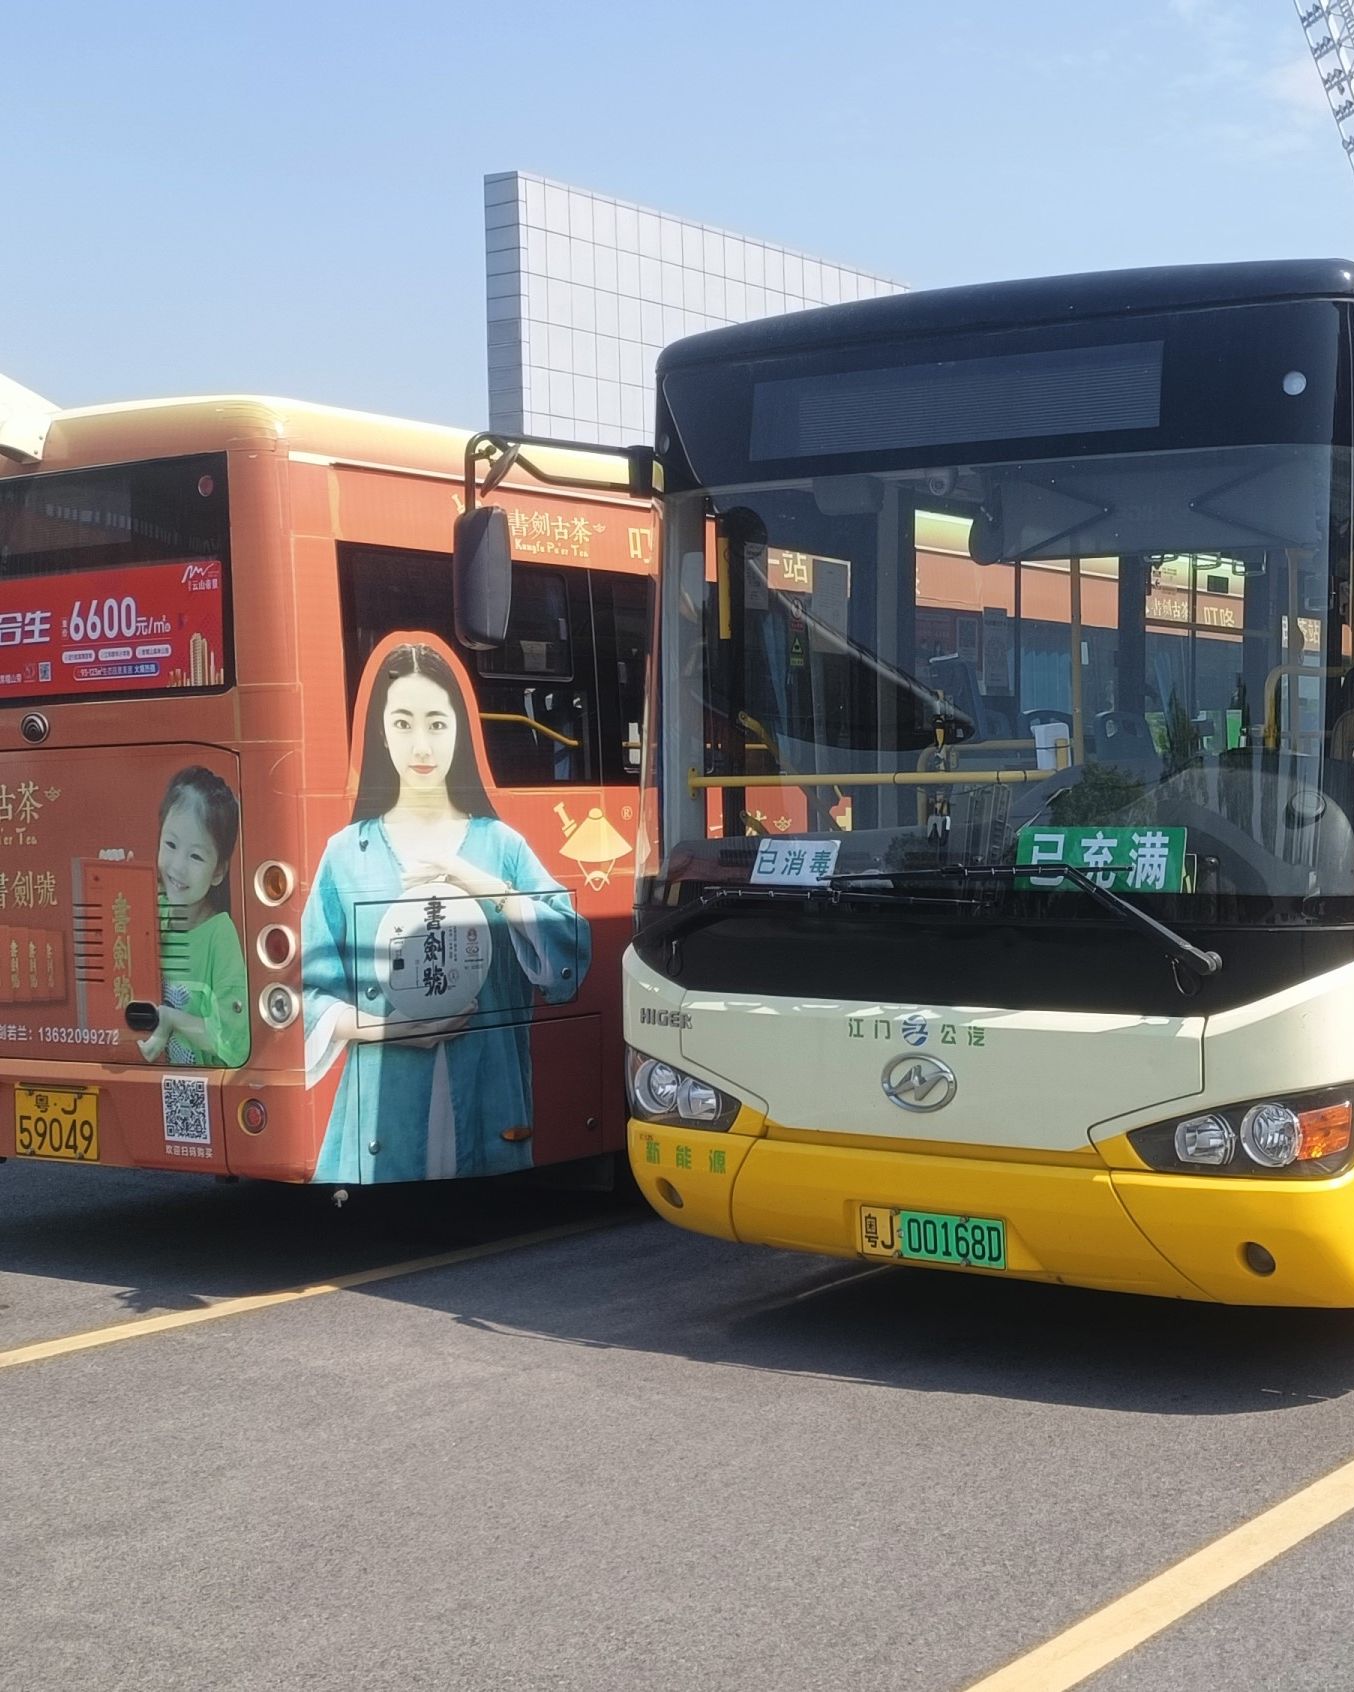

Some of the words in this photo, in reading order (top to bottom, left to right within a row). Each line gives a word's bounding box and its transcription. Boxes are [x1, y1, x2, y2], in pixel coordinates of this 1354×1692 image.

[508, 508, 592, 544] 書劍古茶
[15, 827, 38, 846] Tea
[756, 849, 832, 876] 已消毒
[1029, 830, 1170, 890] 已充满
[423, 896, 448, 997] 書劍號
[640, 1007, 693, 1029] HIGER
[848, 1018, 892, 1041] 江门
[940, 1024, 985, 1047] 公汽
[38, 1028, 119, 1045] 13632099272
[19, 1115, 94, 1154] 59049
[646, 1141, 727, 1175] 新能源
[907, 1217, 1003, 1263] 00168D
